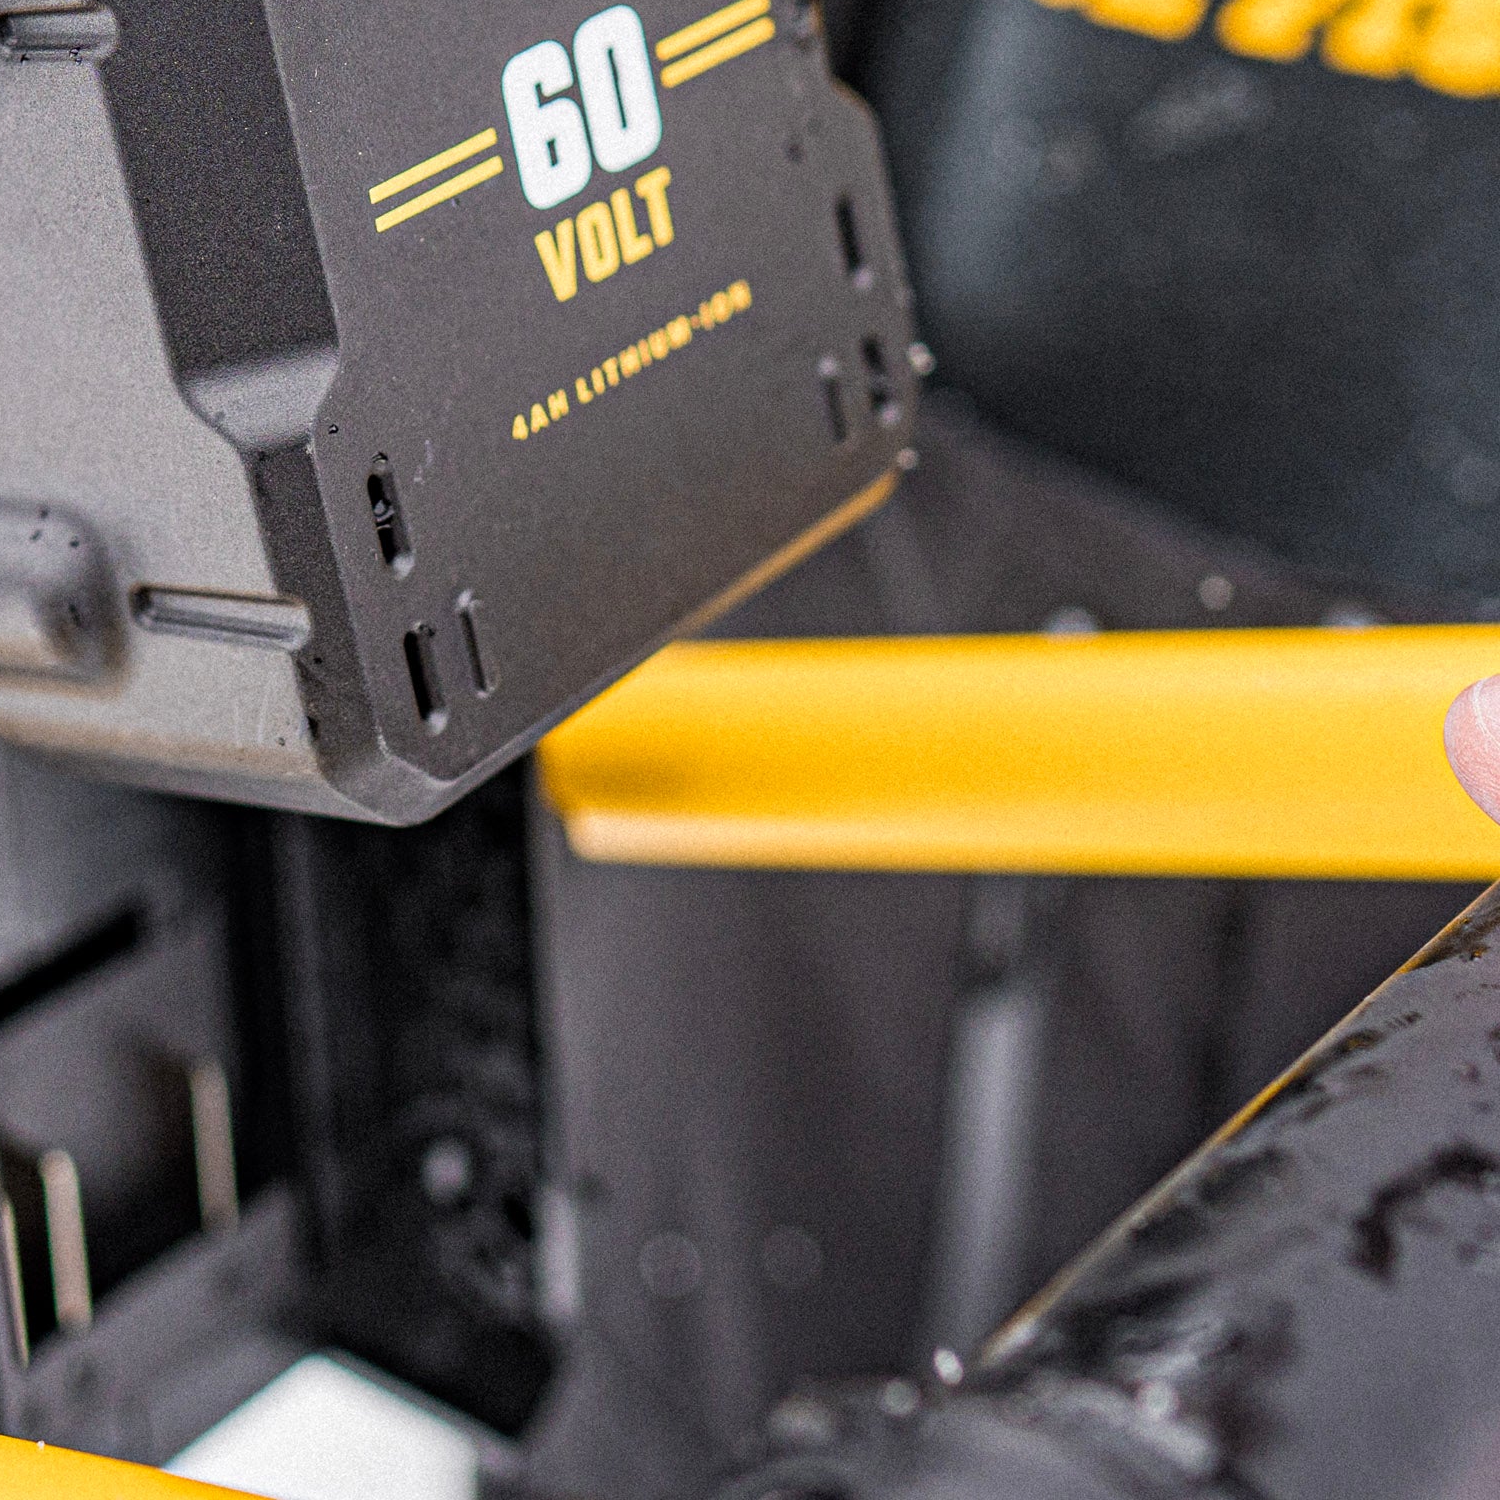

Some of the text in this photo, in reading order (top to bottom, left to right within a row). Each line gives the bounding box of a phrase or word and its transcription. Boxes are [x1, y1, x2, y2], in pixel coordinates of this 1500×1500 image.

[501, 3, 663, 210] 60
[534, 165, 674, 302] VOLT
[512, 279, 752, 440] 4AH LITHIUM-ION
